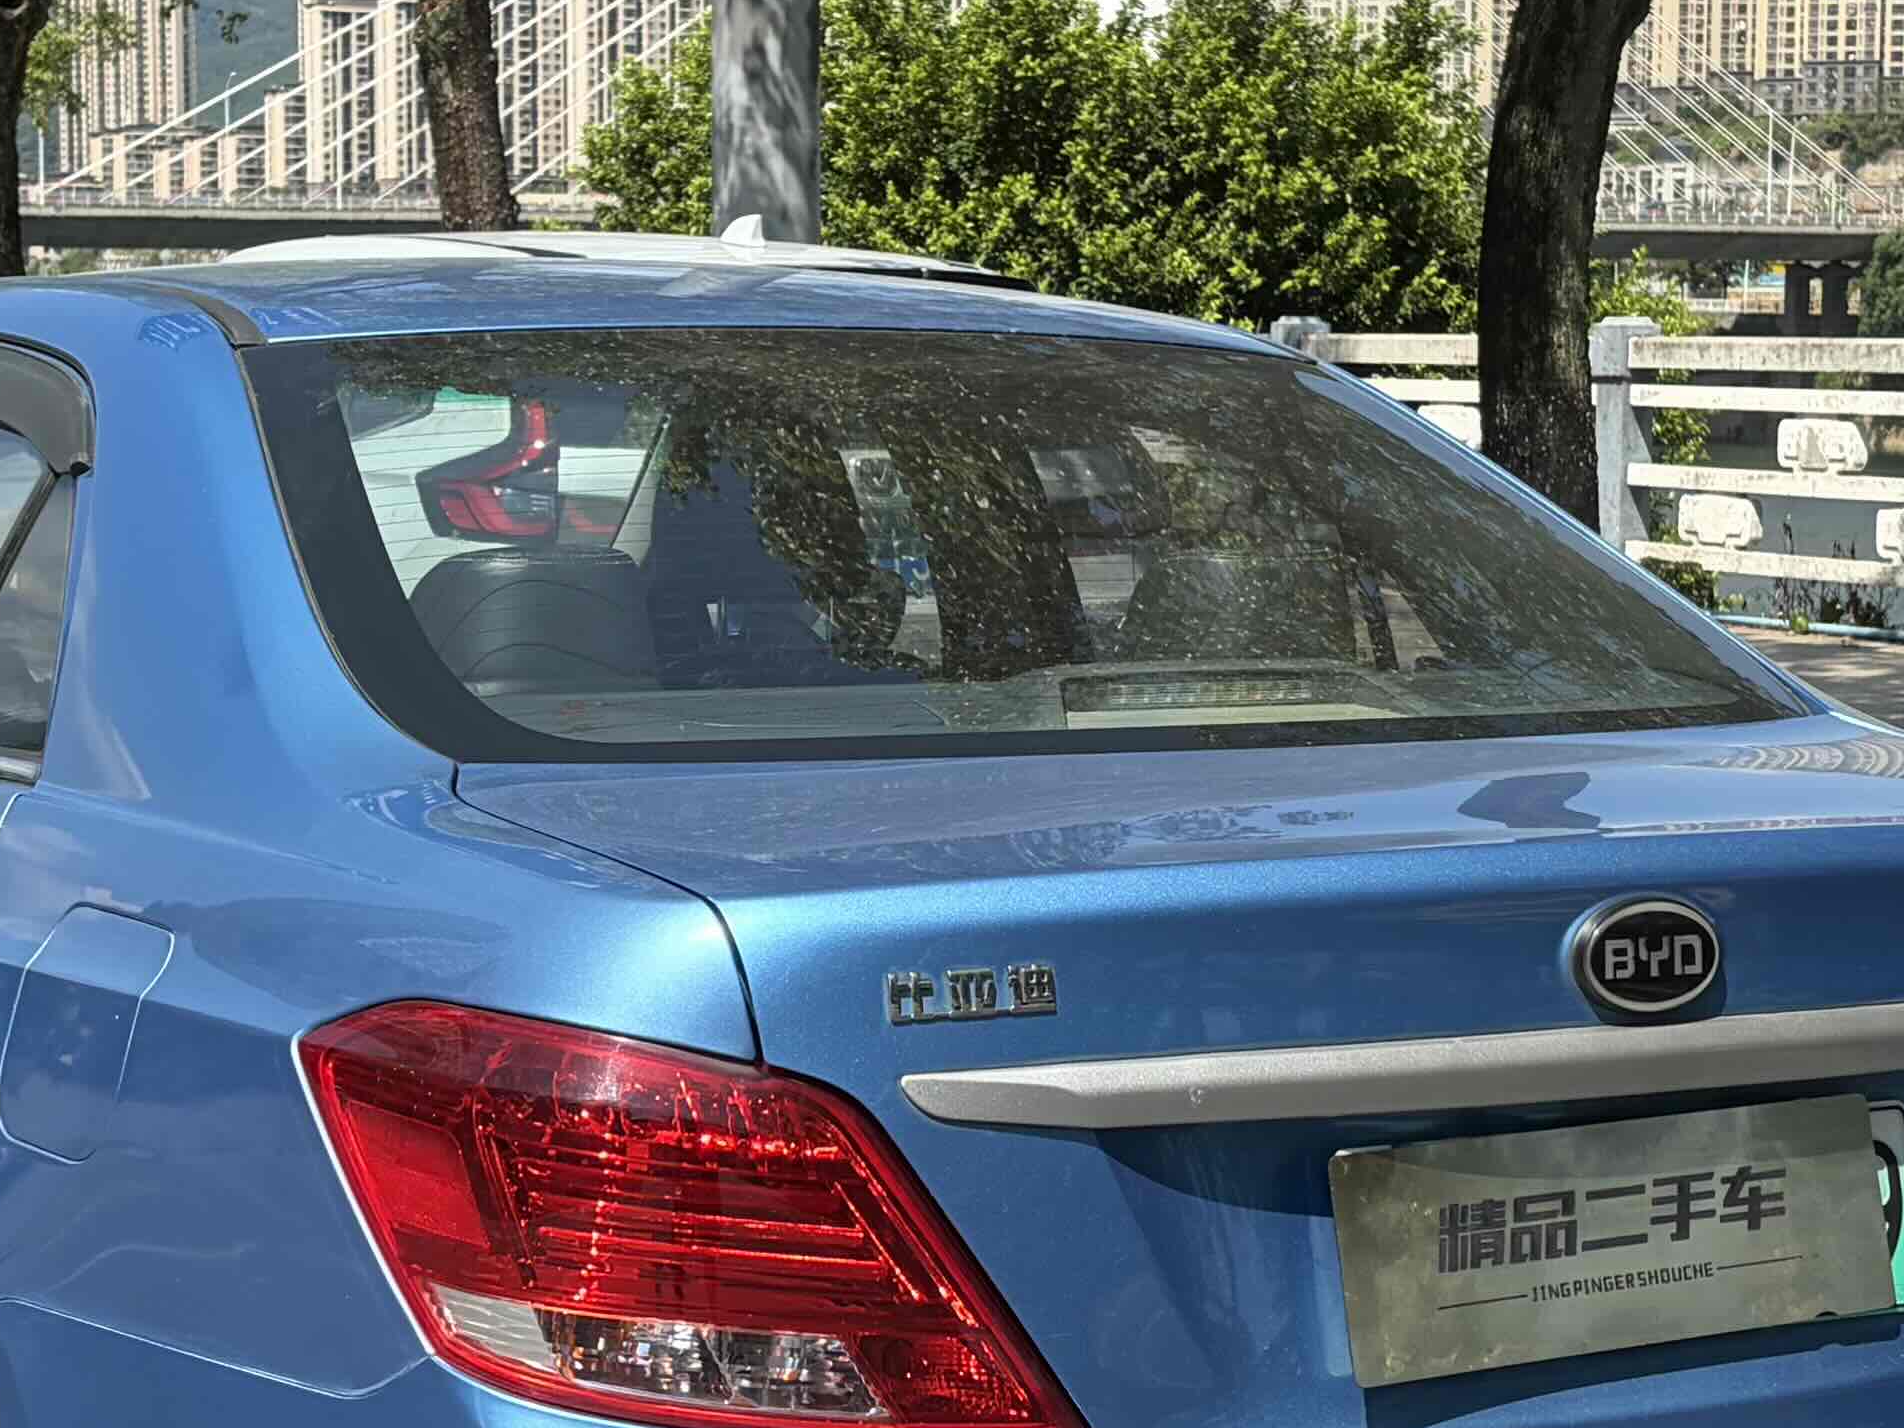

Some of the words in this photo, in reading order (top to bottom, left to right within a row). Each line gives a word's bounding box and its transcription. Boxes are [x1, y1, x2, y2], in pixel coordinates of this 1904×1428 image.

[1602, 935, 1705, 980] BYD
[887, 962, 1059, 1025] 比亚迪
[1437, 1164, 1787, 1275] 精品二手车
